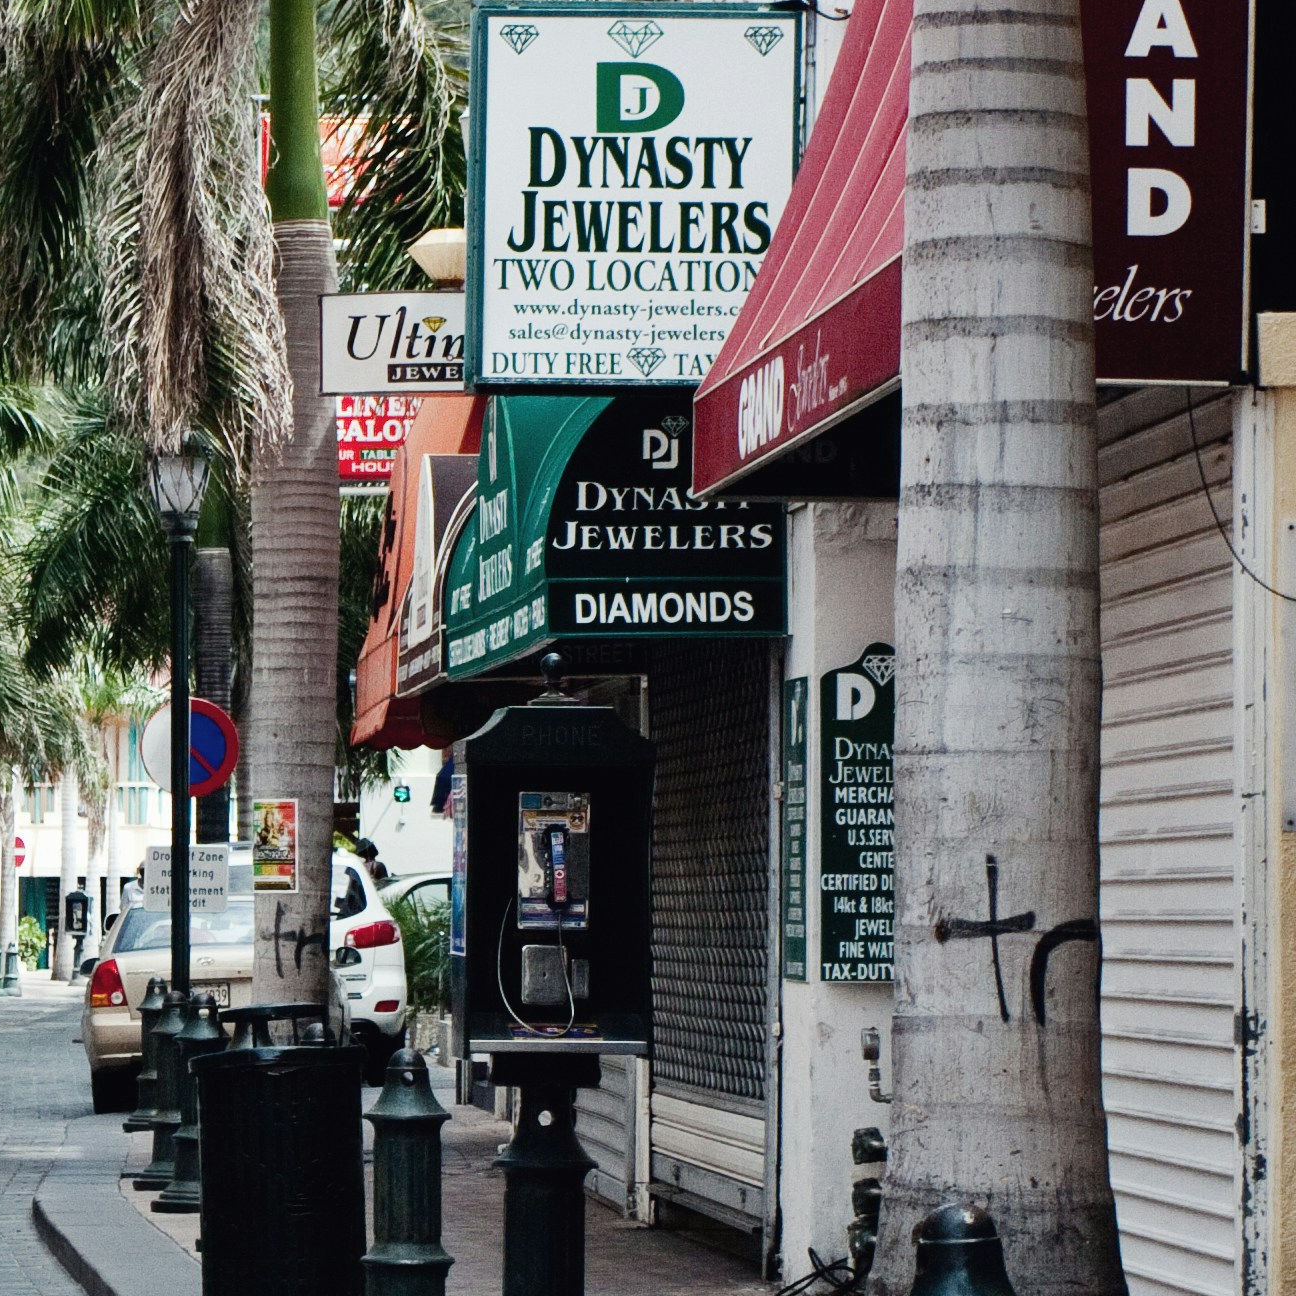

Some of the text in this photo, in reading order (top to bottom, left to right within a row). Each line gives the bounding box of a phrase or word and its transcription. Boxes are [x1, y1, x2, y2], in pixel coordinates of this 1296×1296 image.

[528, 127, 753, 190] DYNASTY
[506, 191, 772, 256] JEWELERS
[493, 258, 575, 292] TWO
[1093, 263, 1193, 323] elers
[513, 298, 741, 320] www.dynasty-jewelers.c
[508, 323, 725, 345] sales@dynasty-jewelers
[391, 366, 464, 381] JEWE
[491, 352, 560, 375] DUTY
[564, 352, 623, 375] FREE
[737, 355, 785, 461] GRAND
[361, 449, 398, 460] TABLE
[351, 462, 395, 474] HOU
[552, 520, 774, 551] JEWELERS
[575, 590, 755, 625] DIAMONDS
[521, 724, 601, 747] PHONE
[834, 736, 895, 761] DYNA
[198, 851, 224, 862] Zone
[820, 873, 878, 892] CERTIFIED
[833, 895, 894, 915] 14kt & 18kt
[854, 918, 895, 940] JEWEL
[838, 941, 866, 959] FINE
